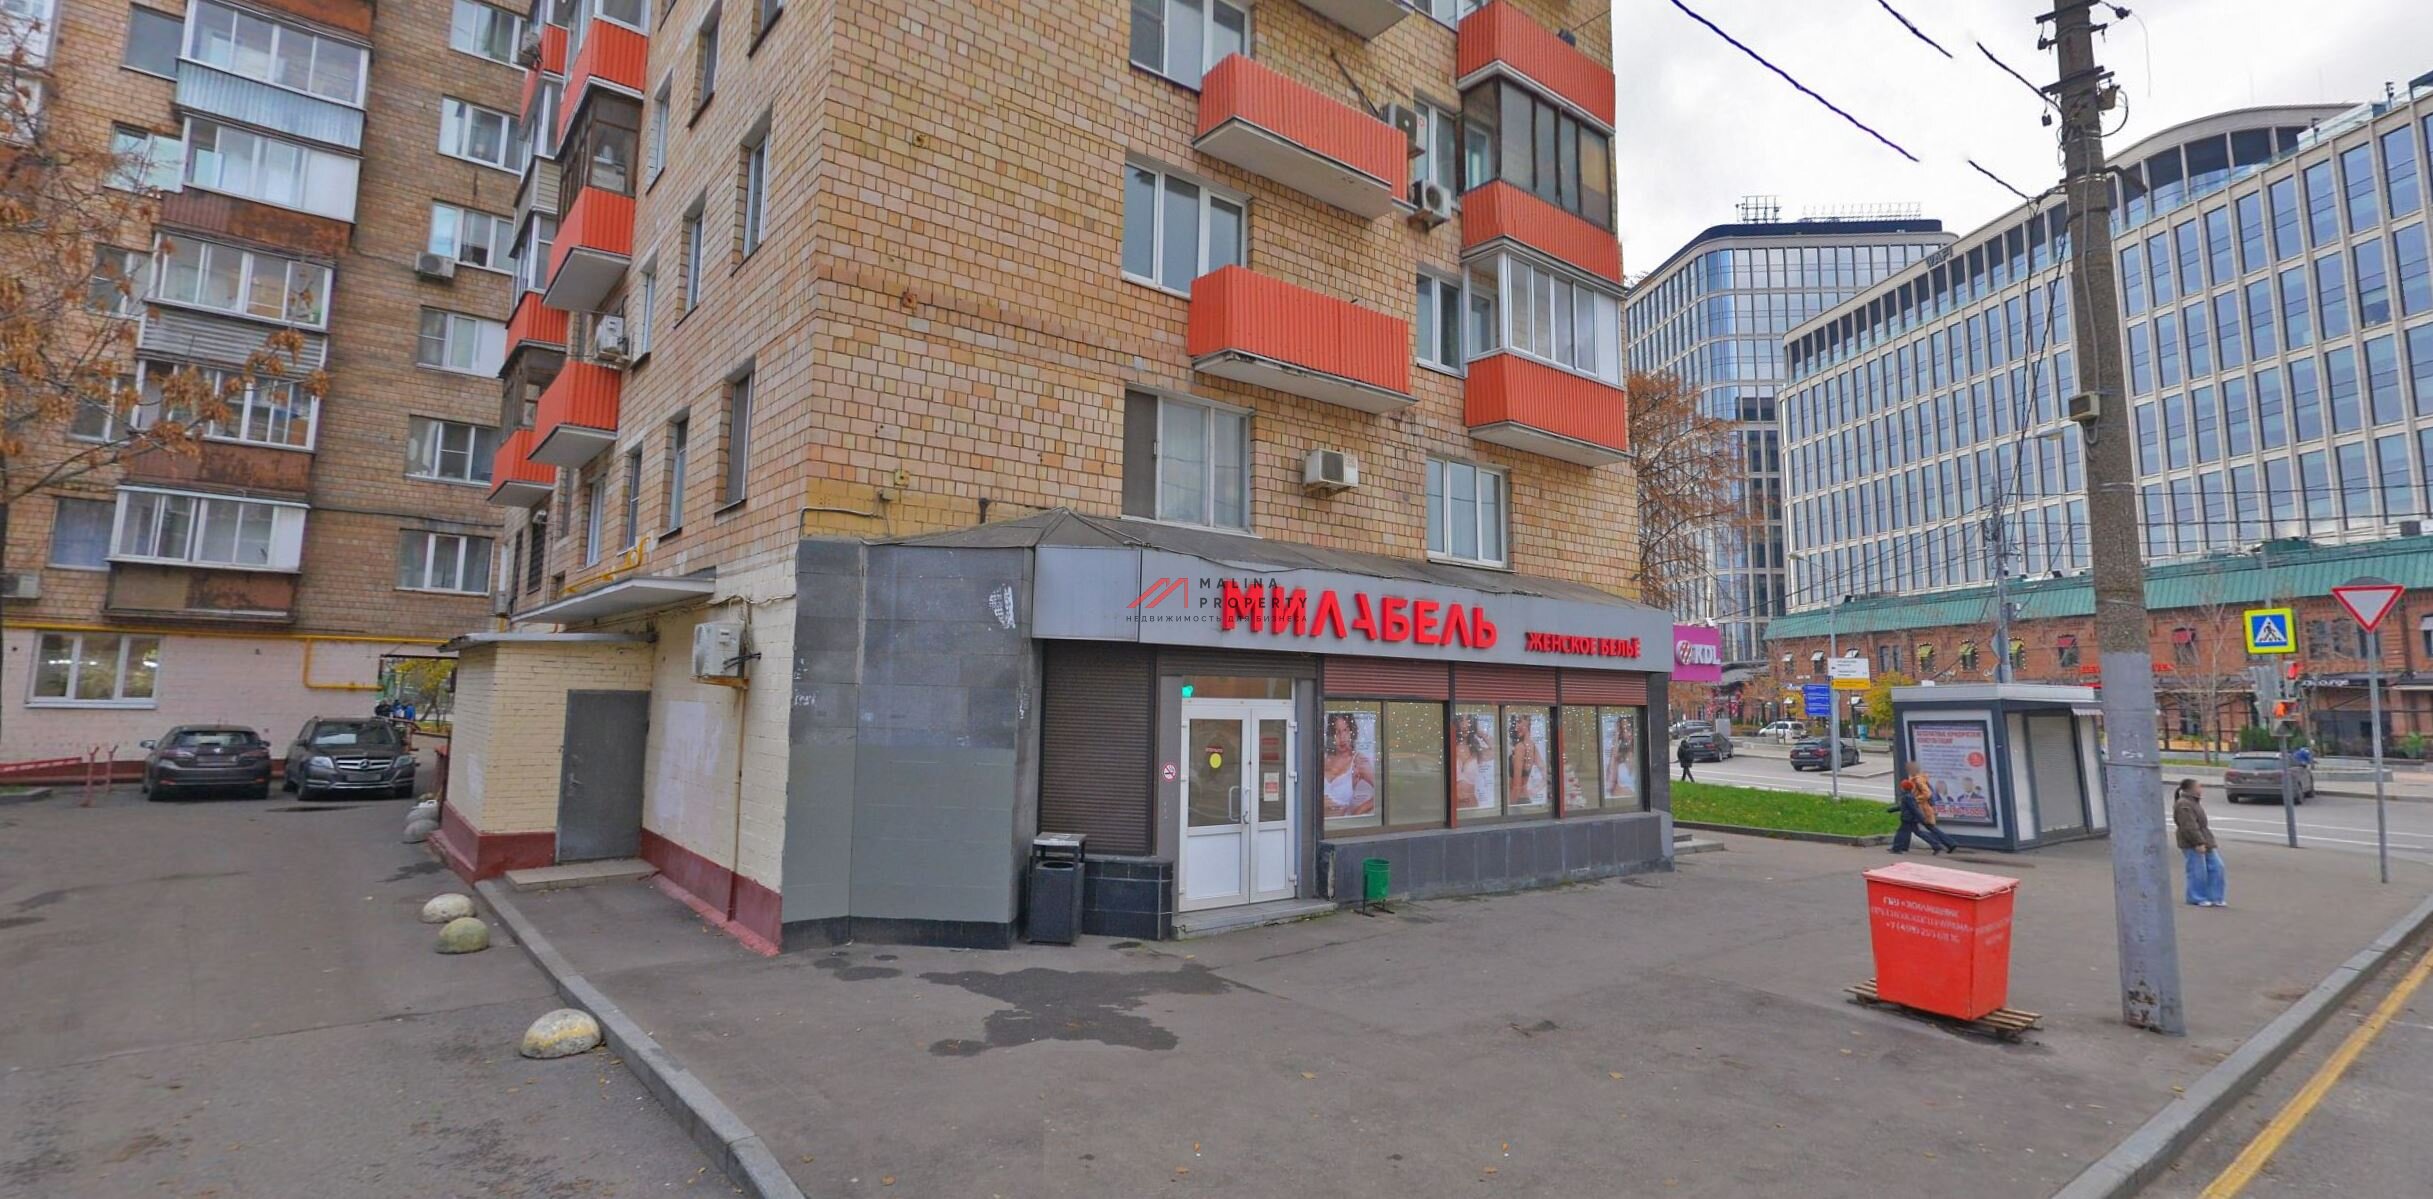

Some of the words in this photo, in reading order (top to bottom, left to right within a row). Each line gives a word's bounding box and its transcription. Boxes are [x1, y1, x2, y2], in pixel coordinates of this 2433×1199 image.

[1221, 578, 1498, 649] МИЛАБЕЛЬ
[1525, 632, 1598, 655] ЖЕНСКОЕ
[1691, 643, 1721, 665] KDL
